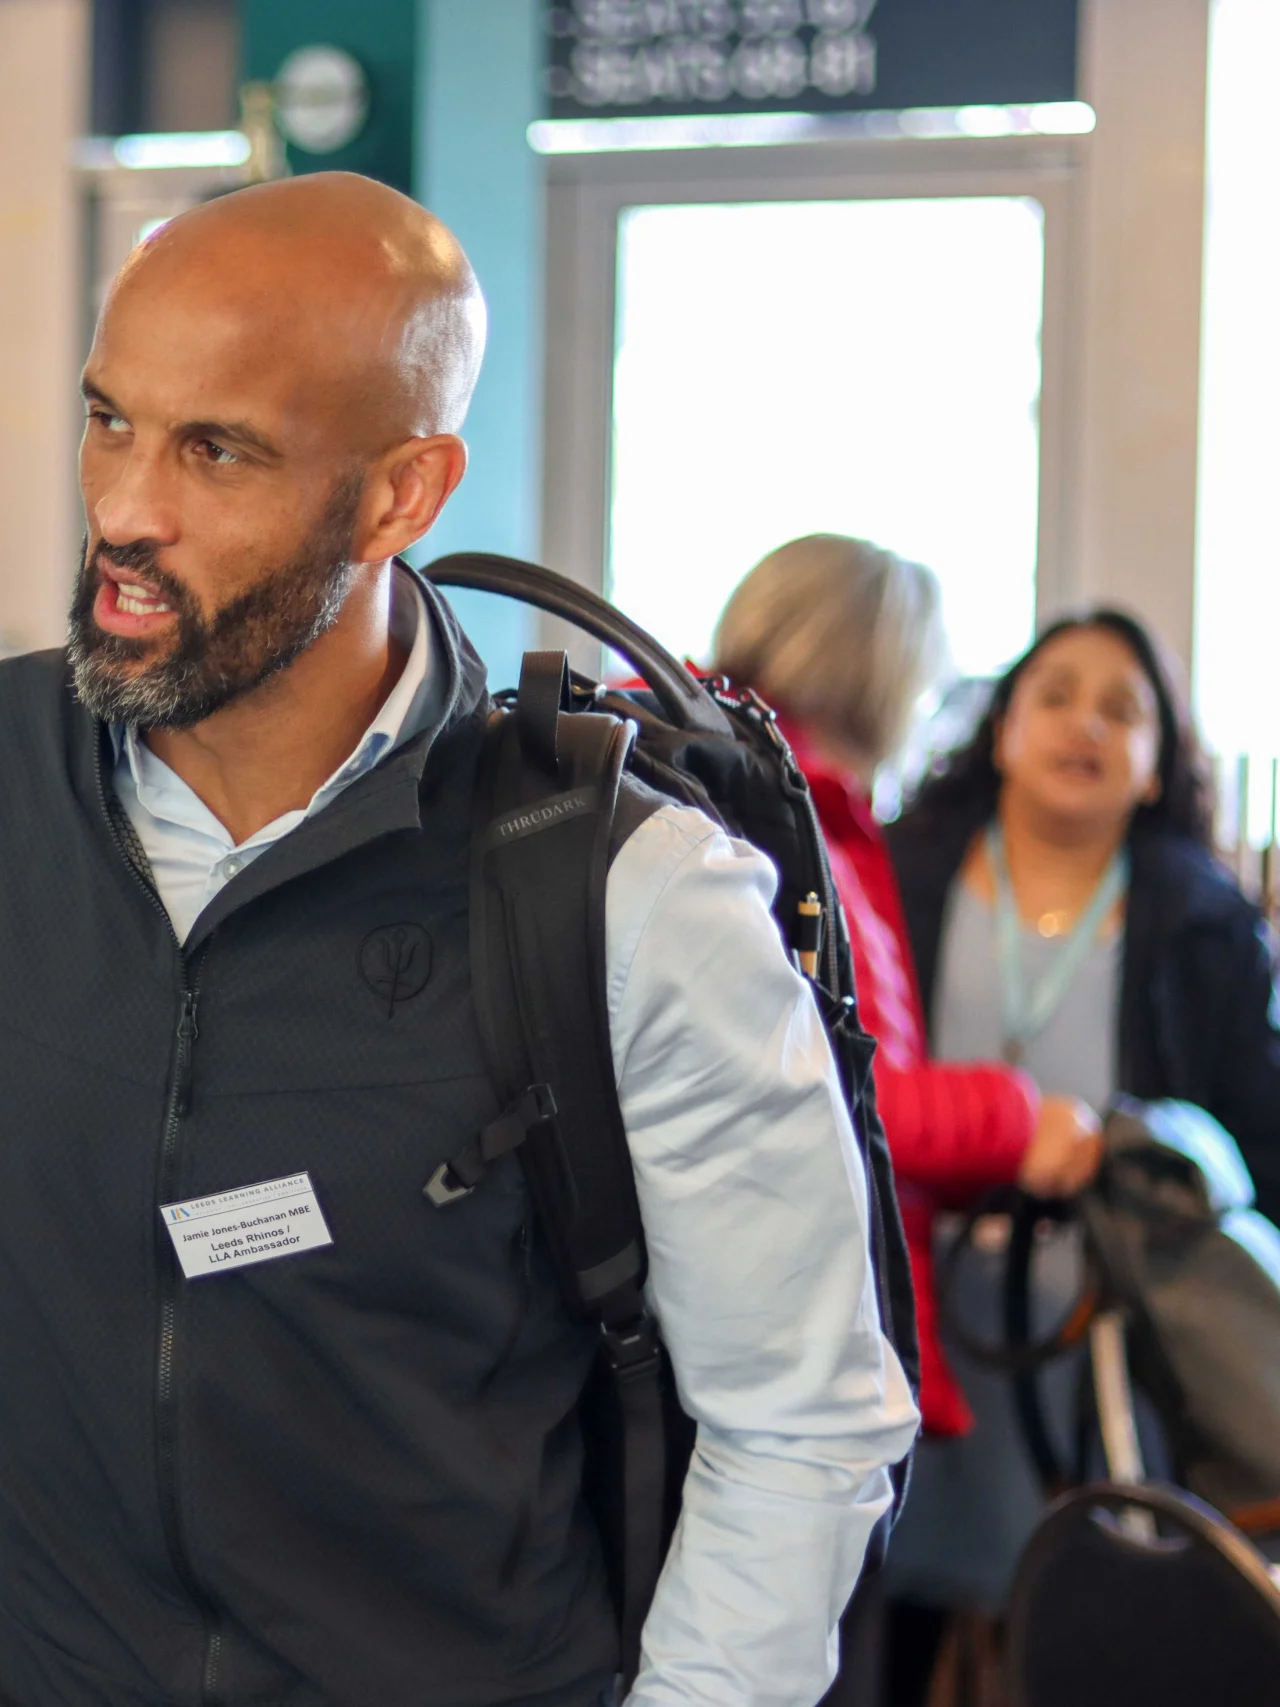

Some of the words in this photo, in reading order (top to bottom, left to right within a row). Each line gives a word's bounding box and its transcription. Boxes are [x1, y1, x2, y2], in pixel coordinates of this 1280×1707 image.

[499, 796, 586, 836] THRUDARK
[190, 1199, 216, 1210] LEEDS
[219, 1188, 261, 1203] LEARNING
[264, 1178, 305, 1192] ALLIANCE
[183, 1229, 209, 1242] Jamie
[211, 1211, 287, 1236] Jones-Buchanan
[288, 1204, 311, 1217] MBE
[208, 1250, 232, 1264] LLA
[233, 1235, 301, 1258] Ambassador
[210, 1237, 244, 1251] Leeds
[245, 1228, 285, 1244] Rhinos
